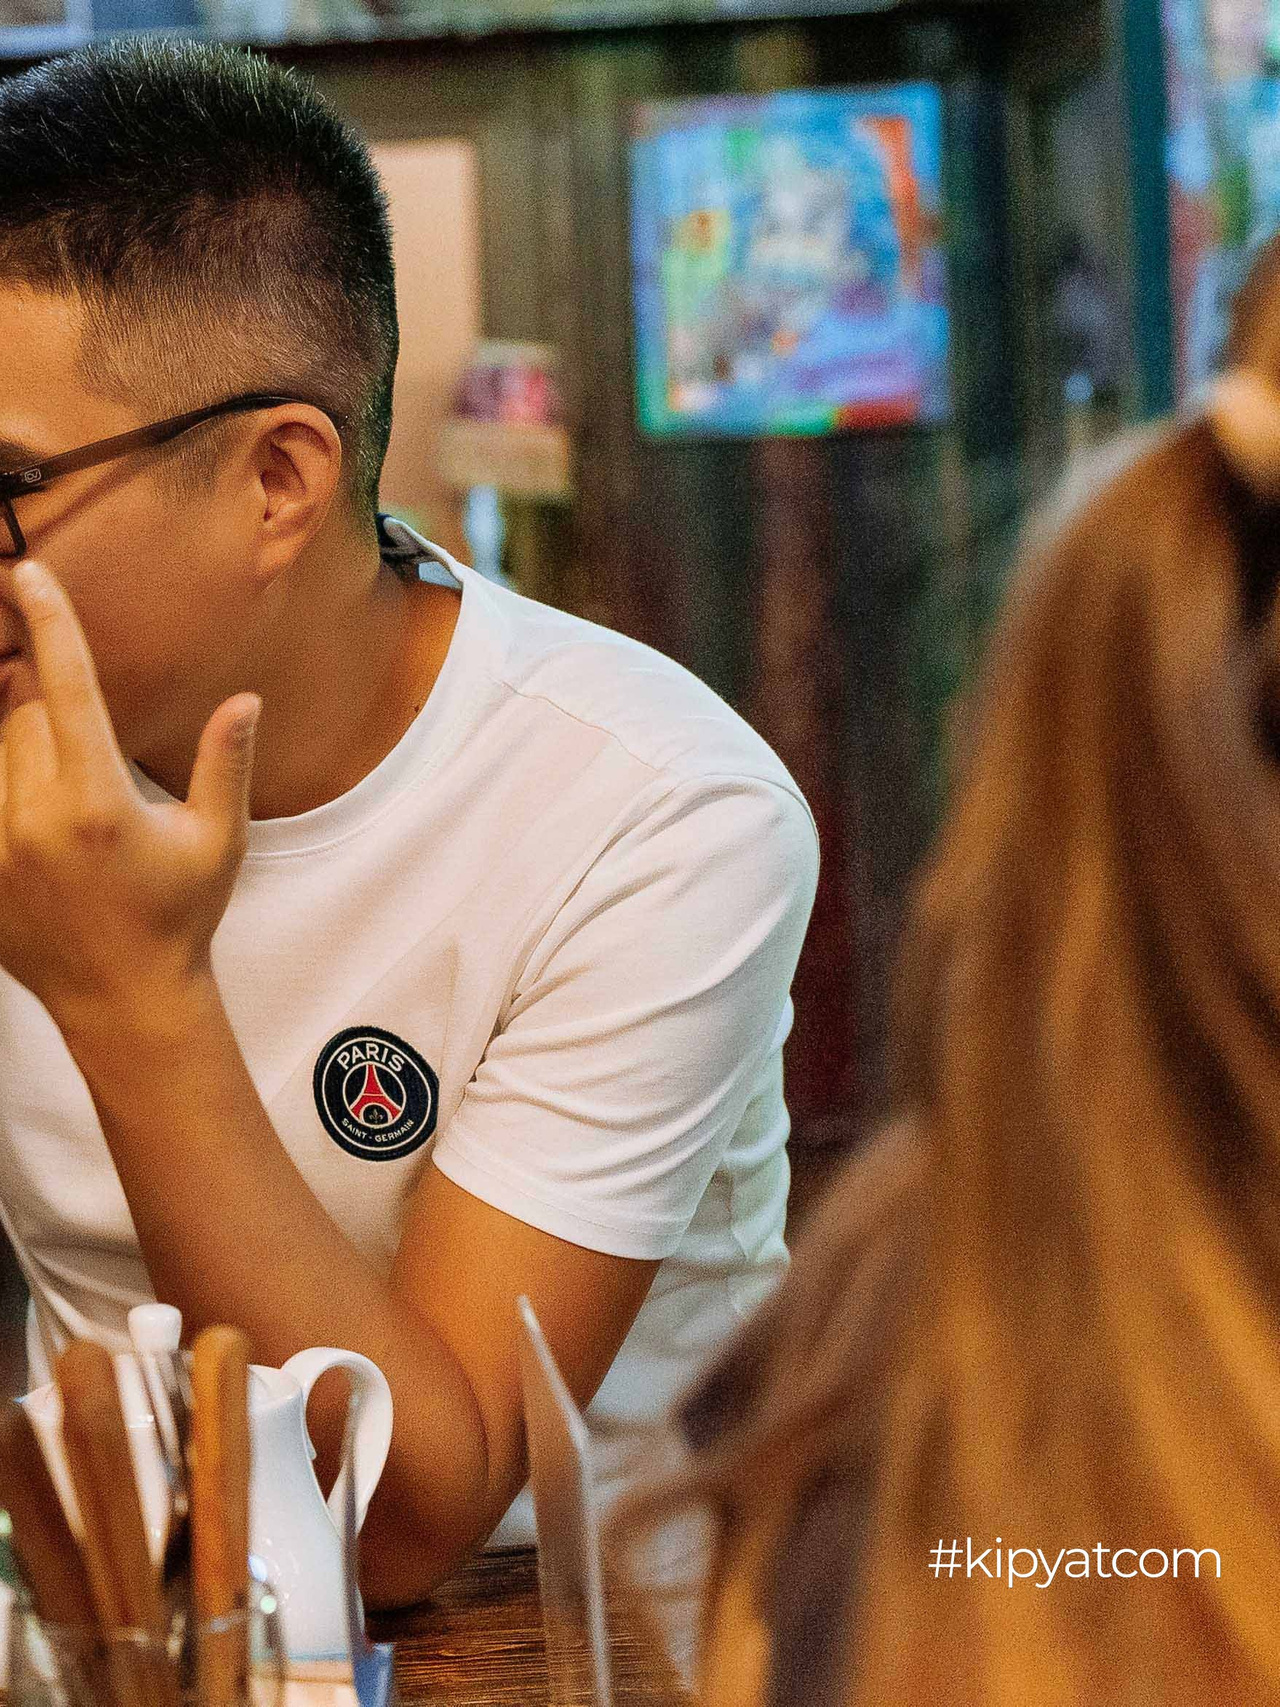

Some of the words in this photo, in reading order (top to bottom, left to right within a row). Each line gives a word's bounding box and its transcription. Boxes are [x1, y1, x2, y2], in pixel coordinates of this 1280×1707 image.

[337, 1043, 404, 1072] PARIS
[341, 1118, 367, 1139] SAINT
[374, 1120, 414, 1142] GERMAIN
